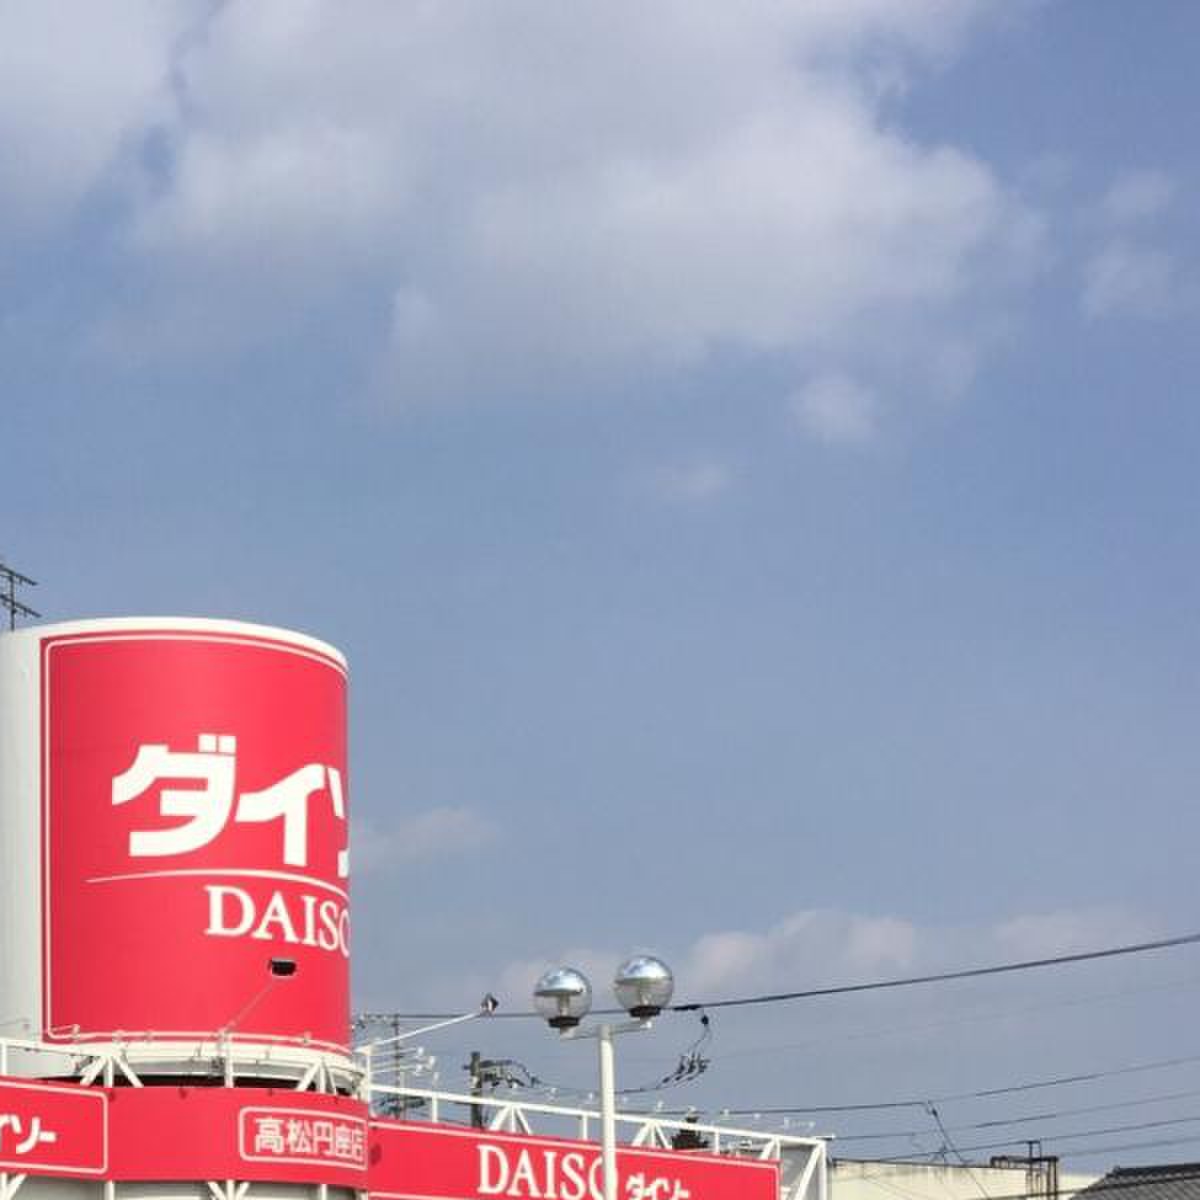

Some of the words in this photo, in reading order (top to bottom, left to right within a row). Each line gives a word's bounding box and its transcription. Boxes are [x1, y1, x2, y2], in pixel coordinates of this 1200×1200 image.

[254, 1116, 364, 1162] 高松円座店
